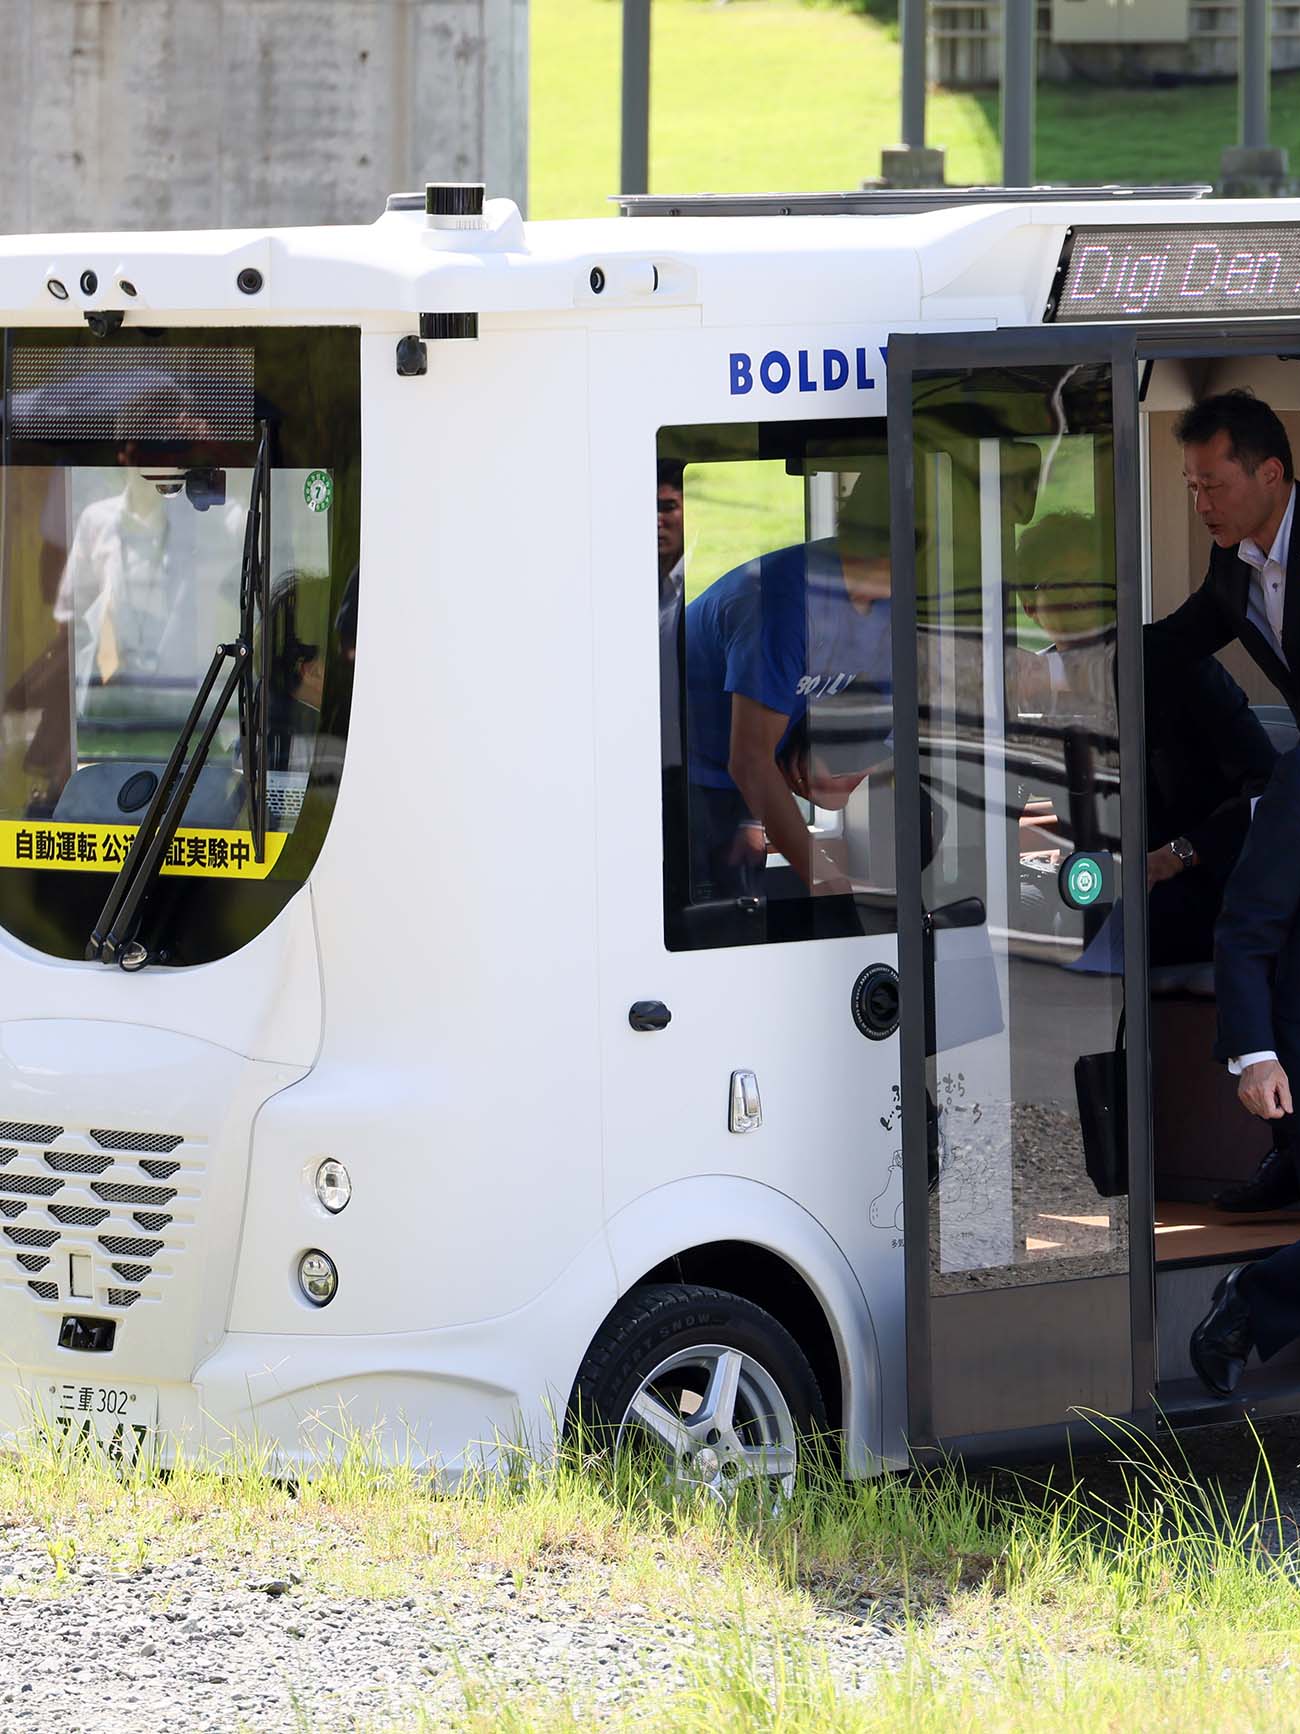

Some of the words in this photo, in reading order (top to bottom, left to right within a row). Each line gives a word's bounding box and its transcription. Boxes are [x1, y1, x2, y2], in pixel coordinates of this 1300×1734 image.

[1071, 245, 1170, 312] Digi
[1179, 243, 1281, 296] Den
[15, 828, 98, 863] 自動運転
[101, 833, 251, 870] 公証実験中
